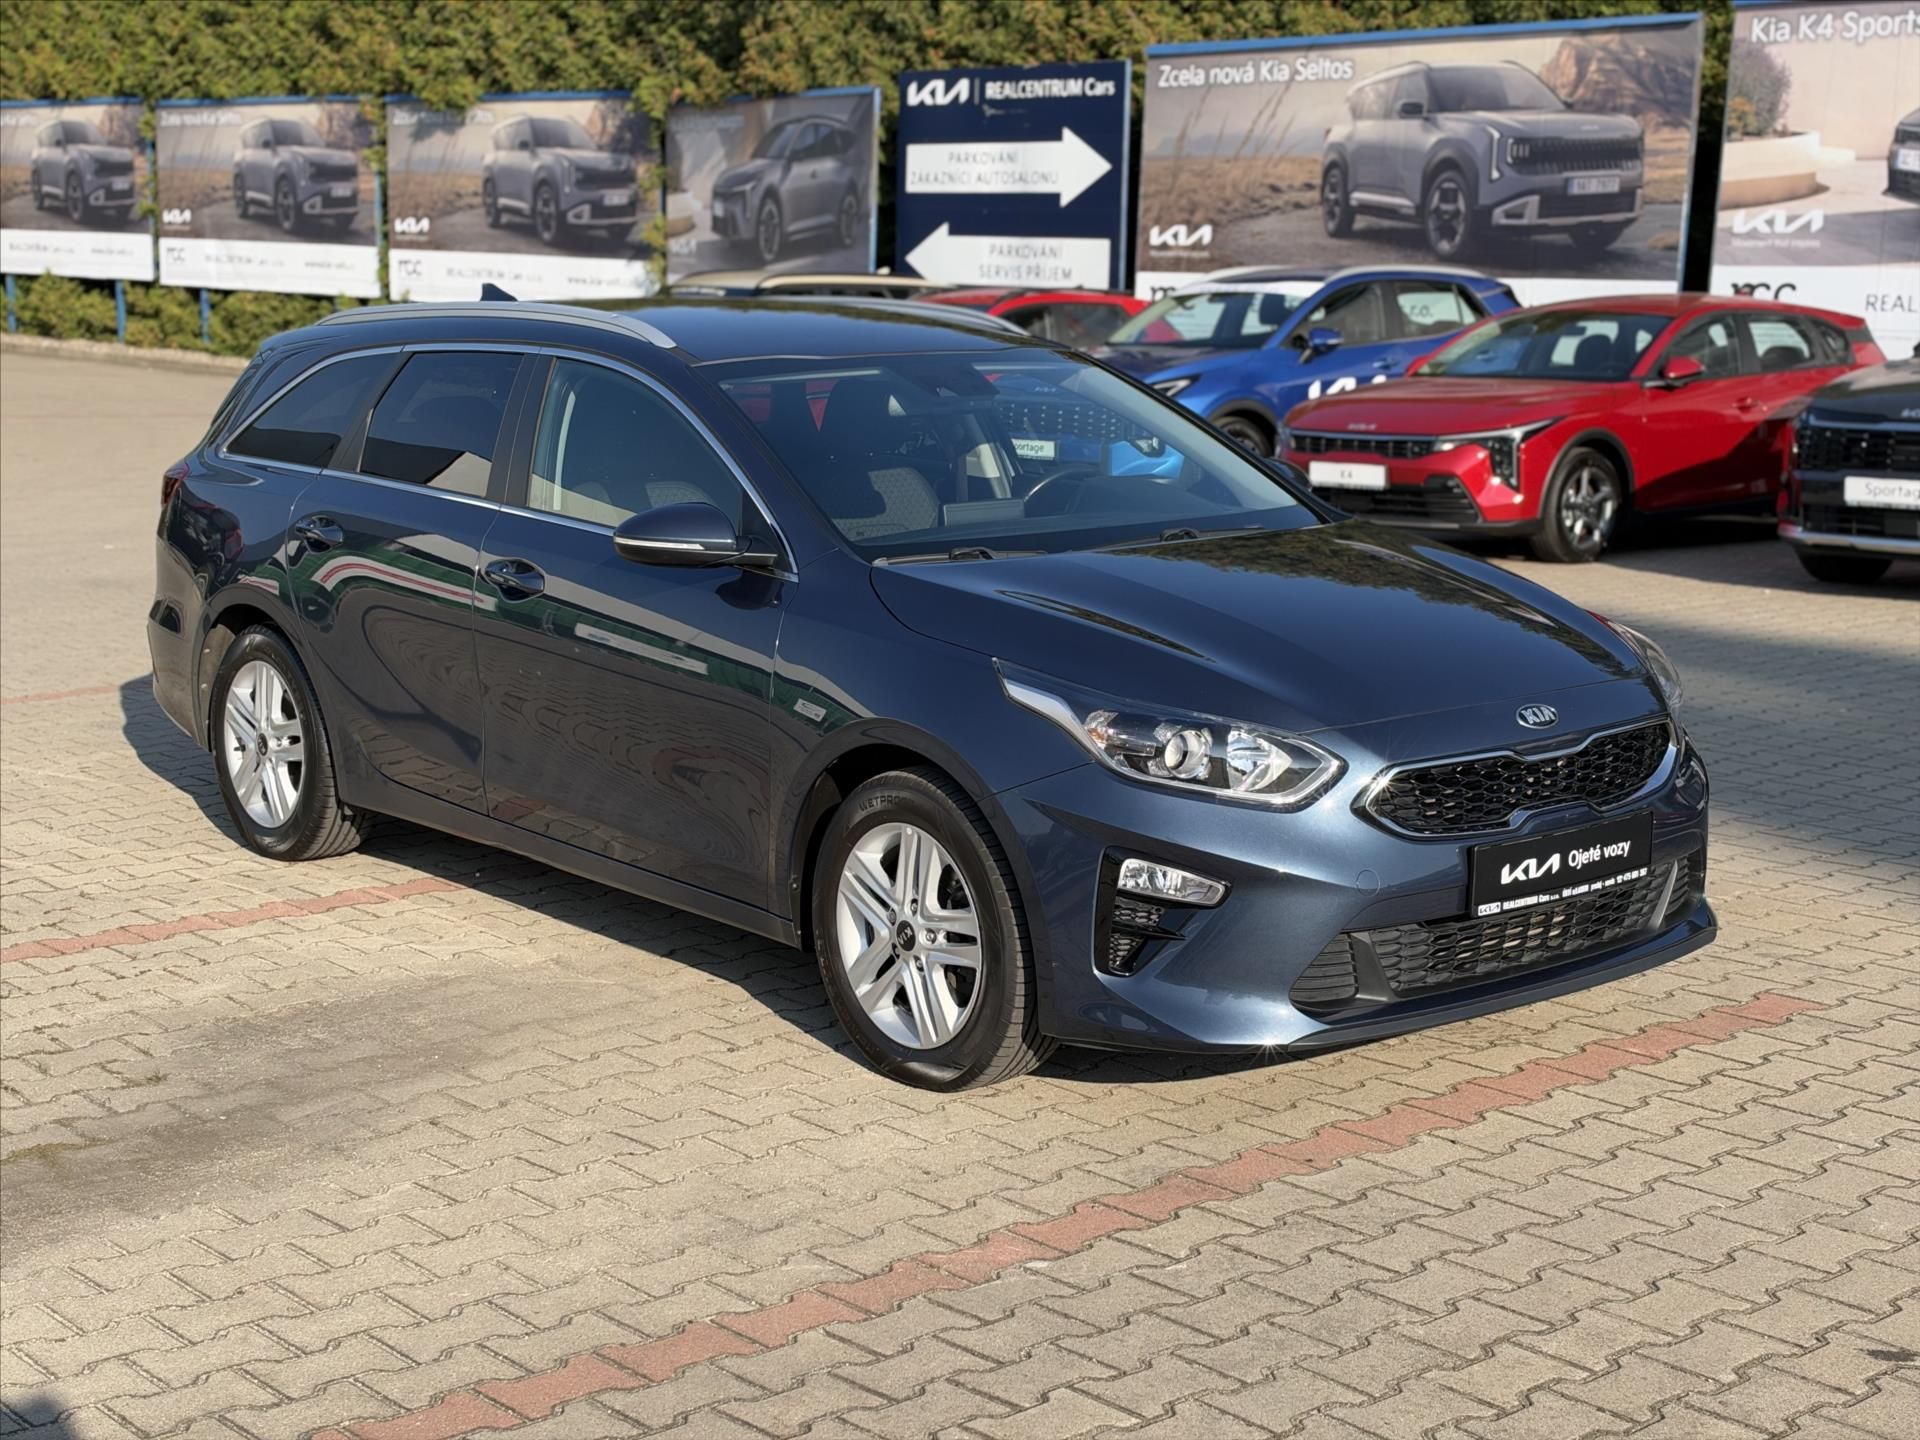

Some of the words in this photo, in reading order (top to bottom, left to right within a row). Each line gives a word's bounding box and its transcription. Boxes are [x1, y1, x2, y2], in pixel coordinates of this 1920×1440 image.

[1751, 16, 1791, 42] Kia
[1798, 13, 1833, 39] K4
[1158, 64, 1205, 88] Zcela
[1210, 61, 1254, 84] nová
[1259, 60, 1290, 82] Kia
[1294, 57, 1353, 81] Seltos
[907, 77, 970, 106] KIA
[985, 78, 1083, 99] REALCENTRUM
[1084, 77, 1116, 97] Cars
[394, 216, 430, 233] KIA
[1732, 208, 1824, 234] KIA
[1149, 224, 1212, 246] KIA
[1865, 293, 1919, 312] REAL
[1520, 706, 1556, 725] KIA
[1501, 852, 1560, 885] KIA
[1568, 844, 1601, 870] Ojeté
[1603, 840, 1631, 858] vozy
